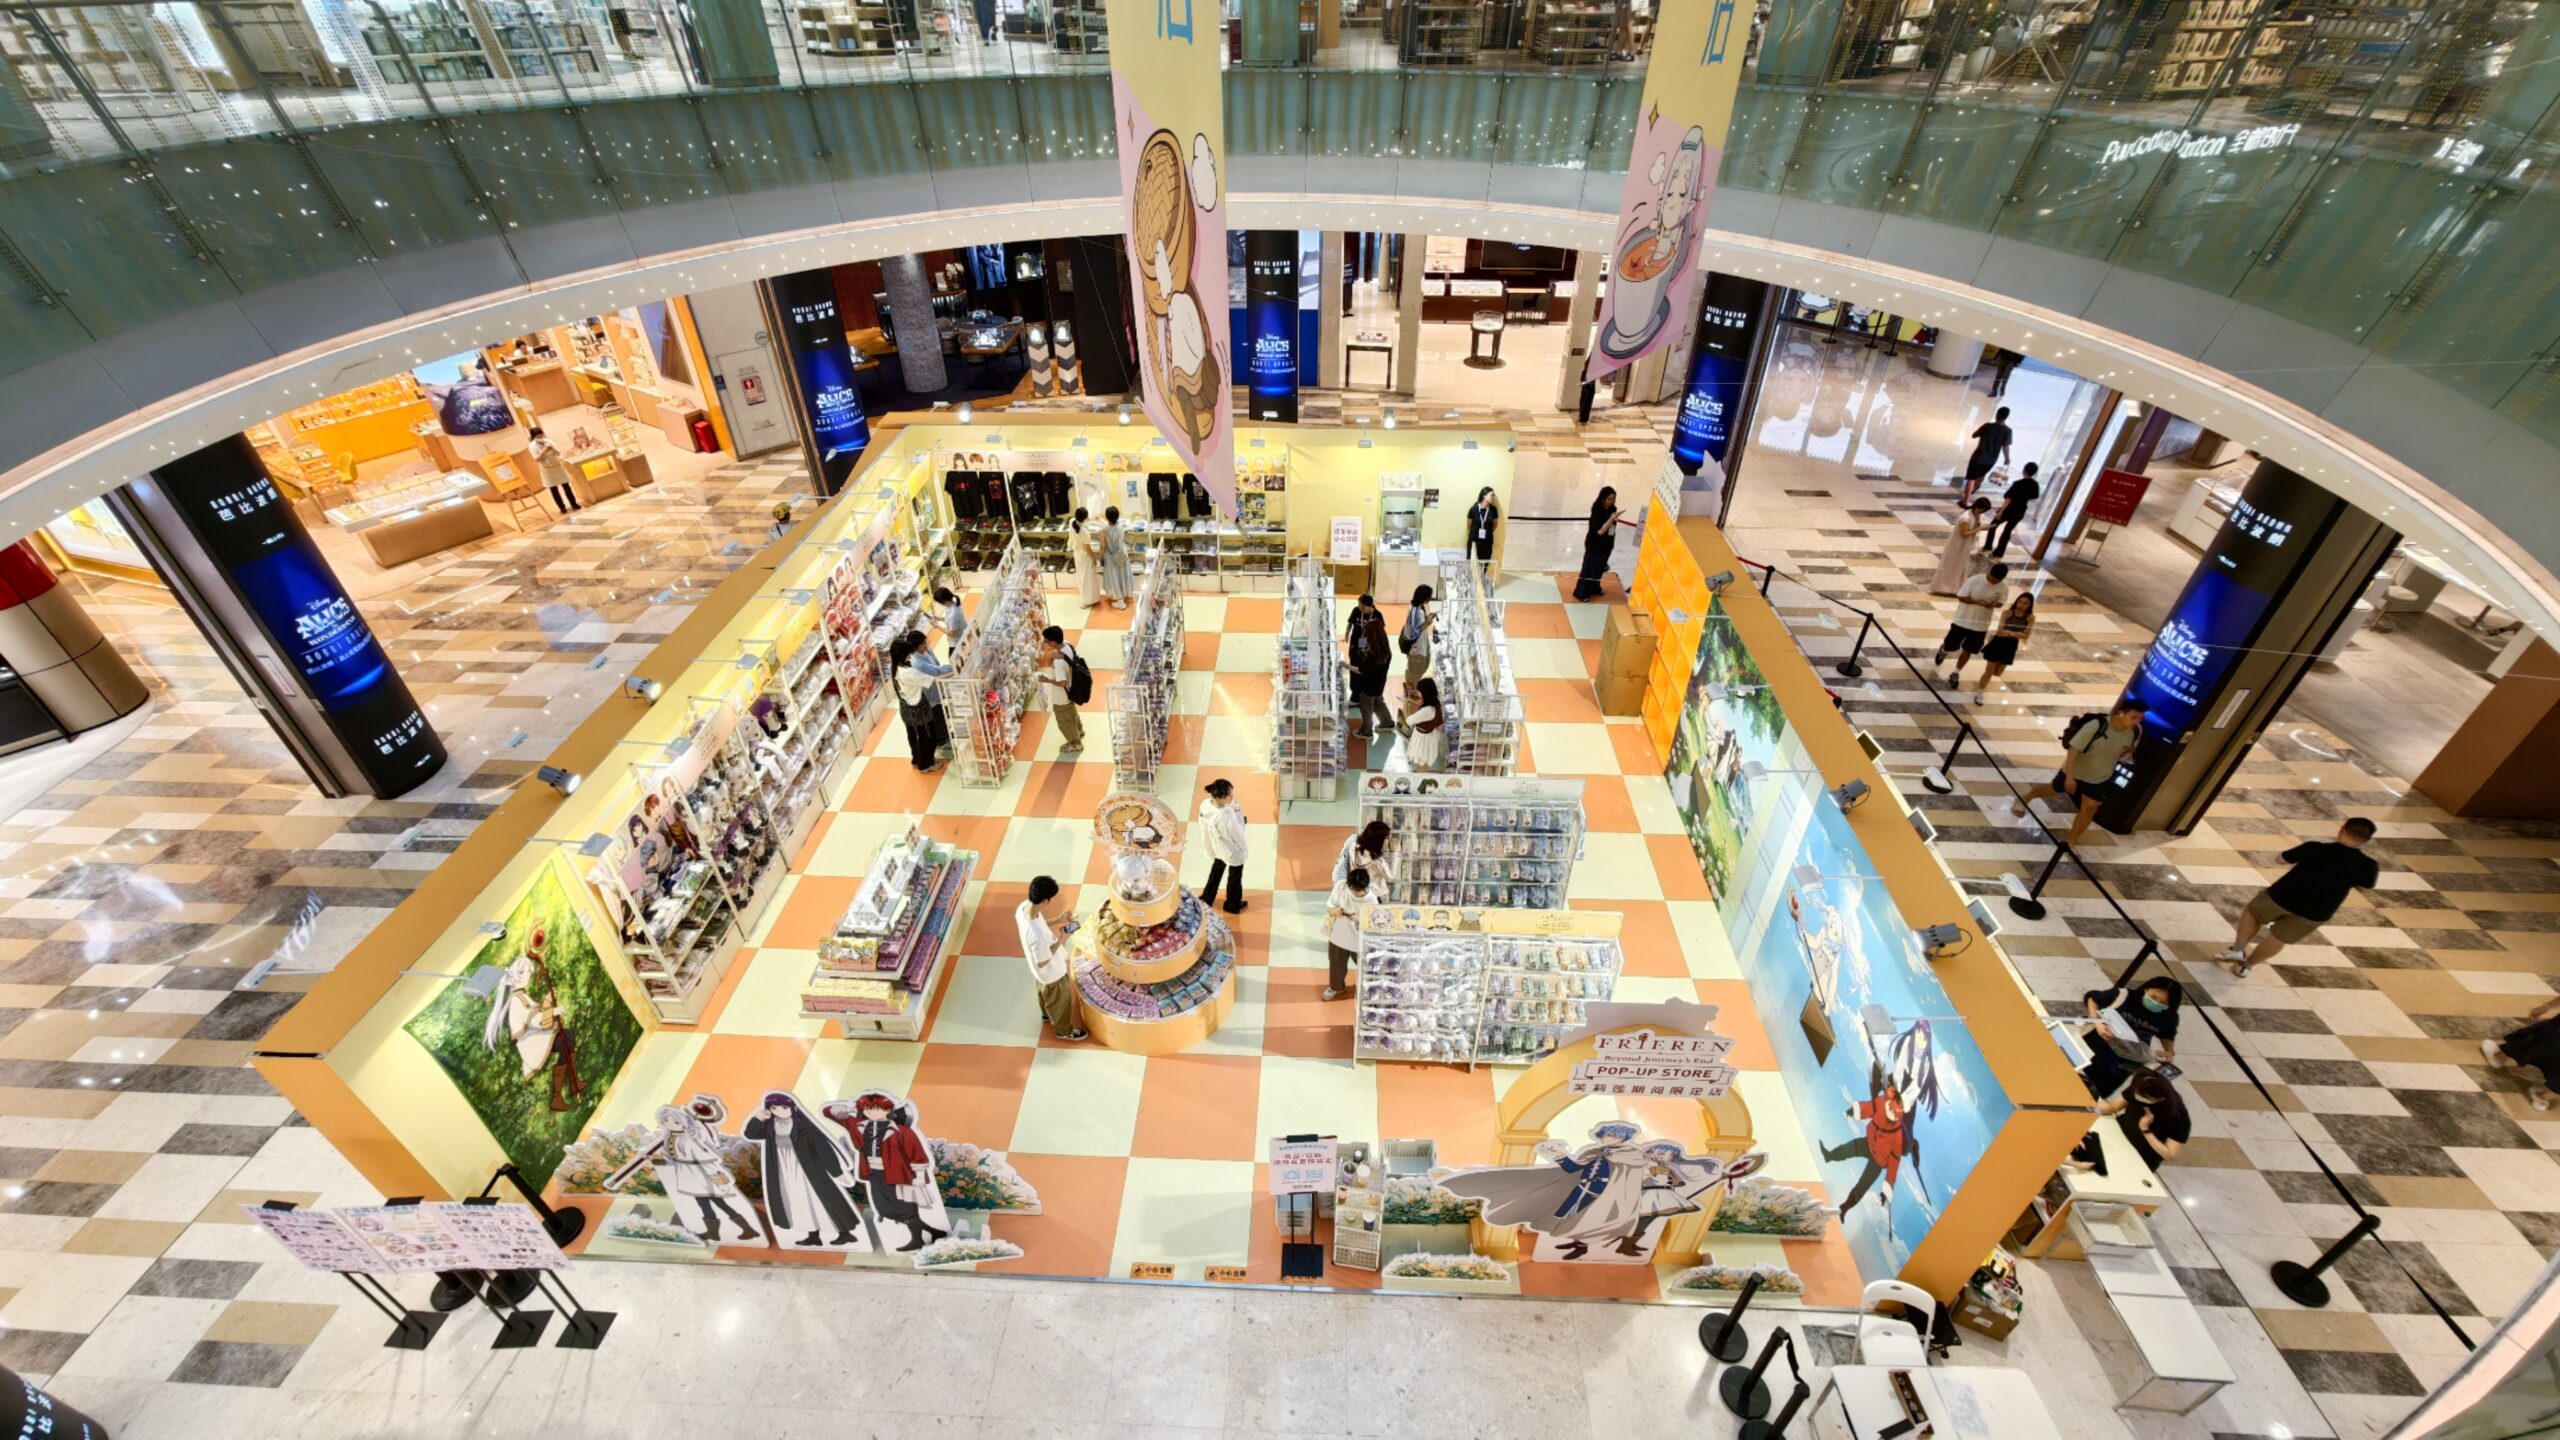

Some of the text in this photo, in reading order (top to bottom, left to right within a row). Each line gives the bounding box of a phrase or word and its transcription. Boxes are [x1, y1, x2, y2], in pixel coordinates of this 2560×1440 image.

[295, 597, 350, 640] ALICE
[2159, 620, 2209, 667] ALICE
[1598, 1033, 1731, 1053] FRIEREN
[1603, 1054, 1642, 1064] Beyond
[1692, 1057, 1714, 1065] End
[1596, 1065, 1714, 1079] POP-UP STORE
[1572, 1082, 1724, 1097] 芙莉莲期间限定店
